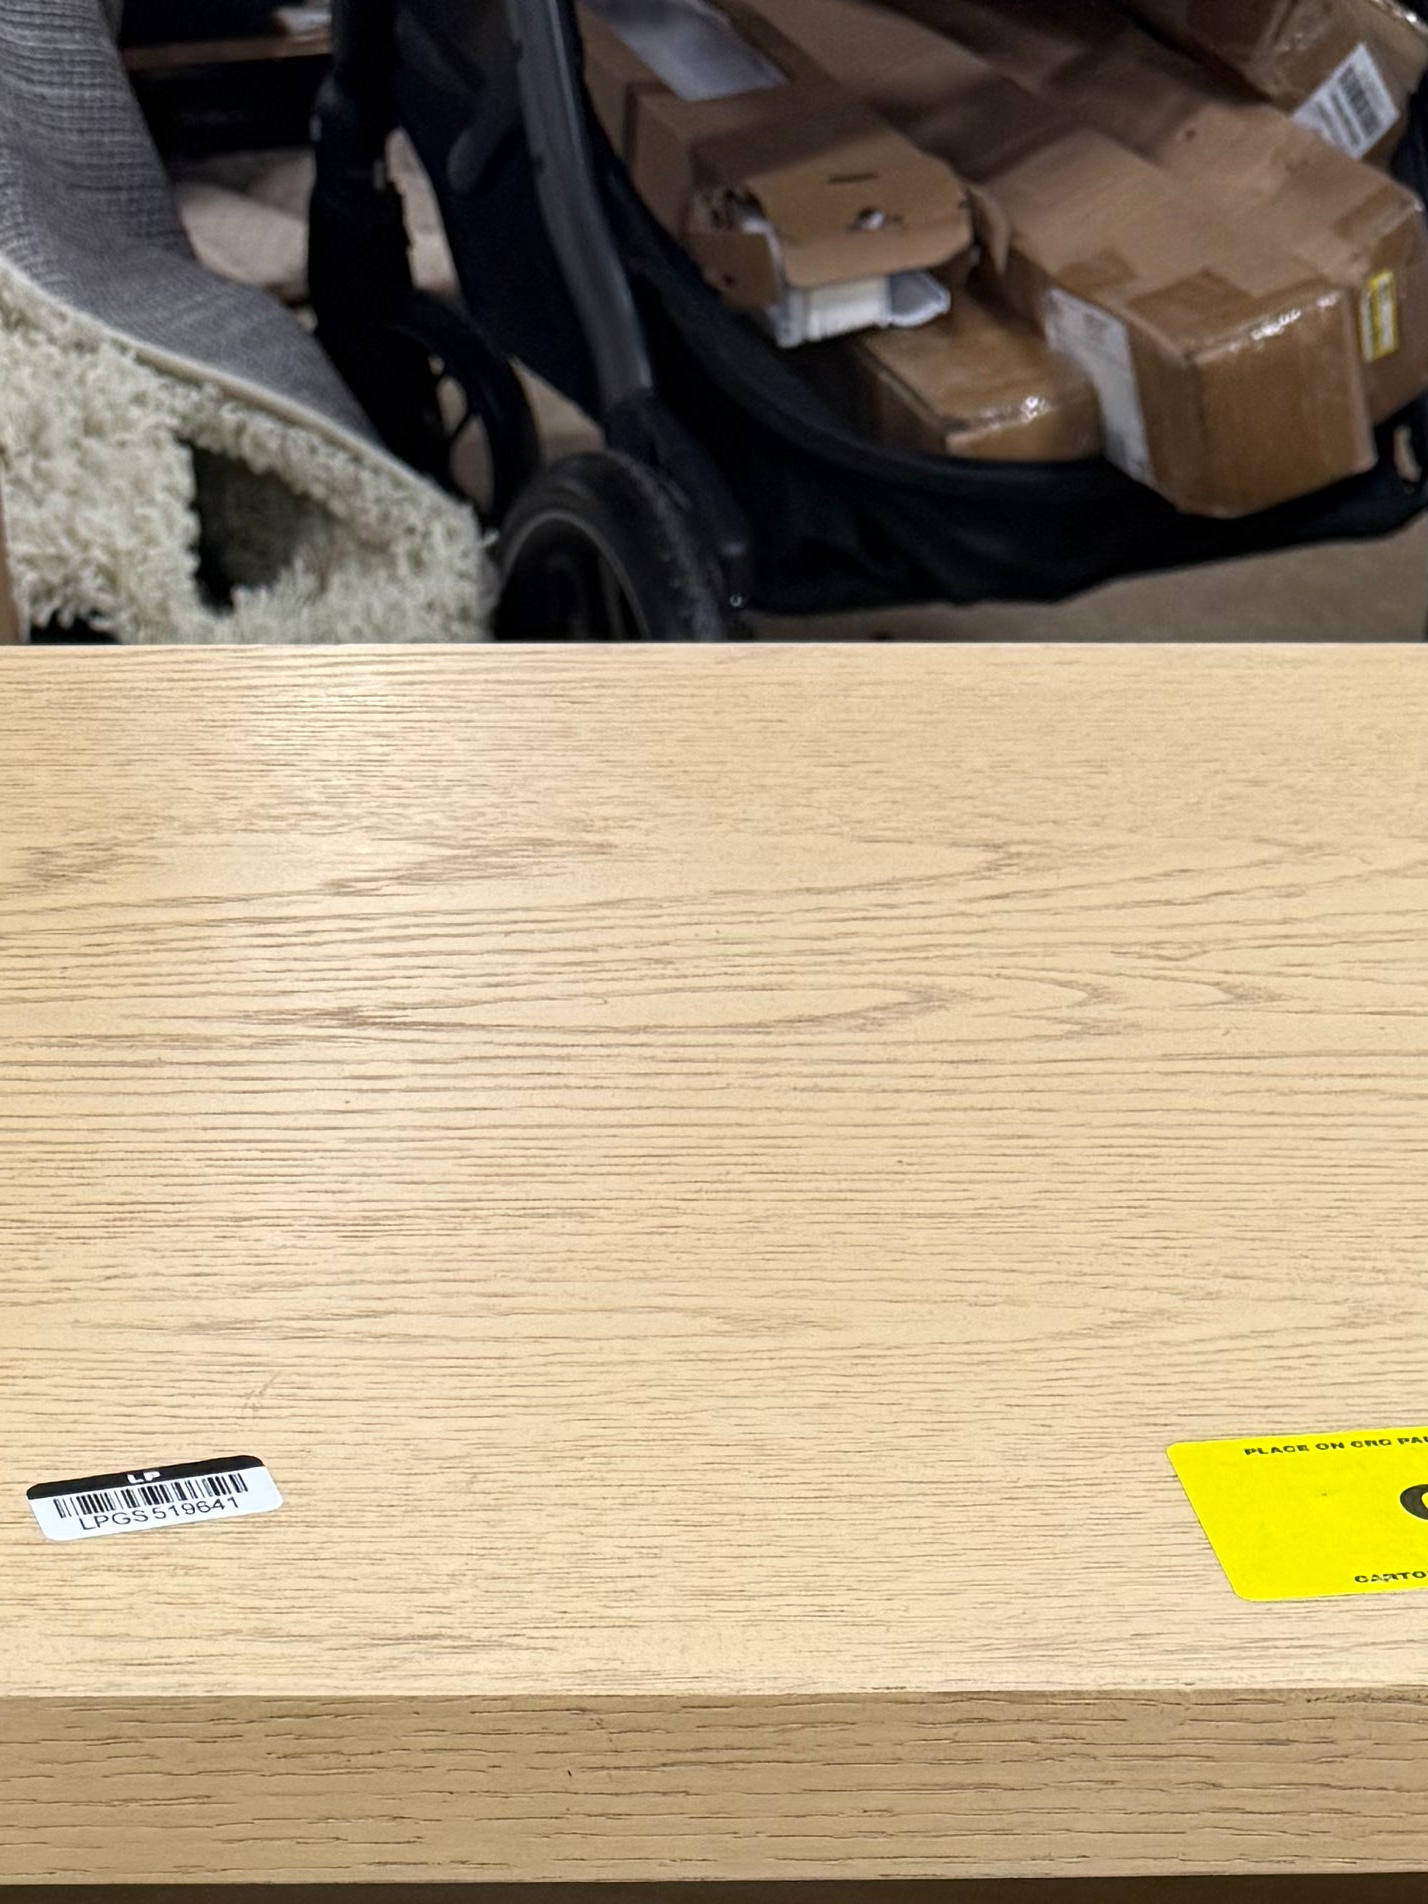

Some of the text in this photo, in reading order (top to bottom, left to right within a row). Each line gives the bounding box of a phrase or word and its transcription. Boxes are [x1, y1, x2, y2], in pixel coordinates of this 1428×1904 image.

[1244, 1444, 1310, 1458] PLACE
[1317, 1440, 1346, 1451] ON
[1351, 1436, 1392, 1449] CRC
[126, 1471, 161, 1483] LP
[78, 1496, 239, 1531] LPGS519641
